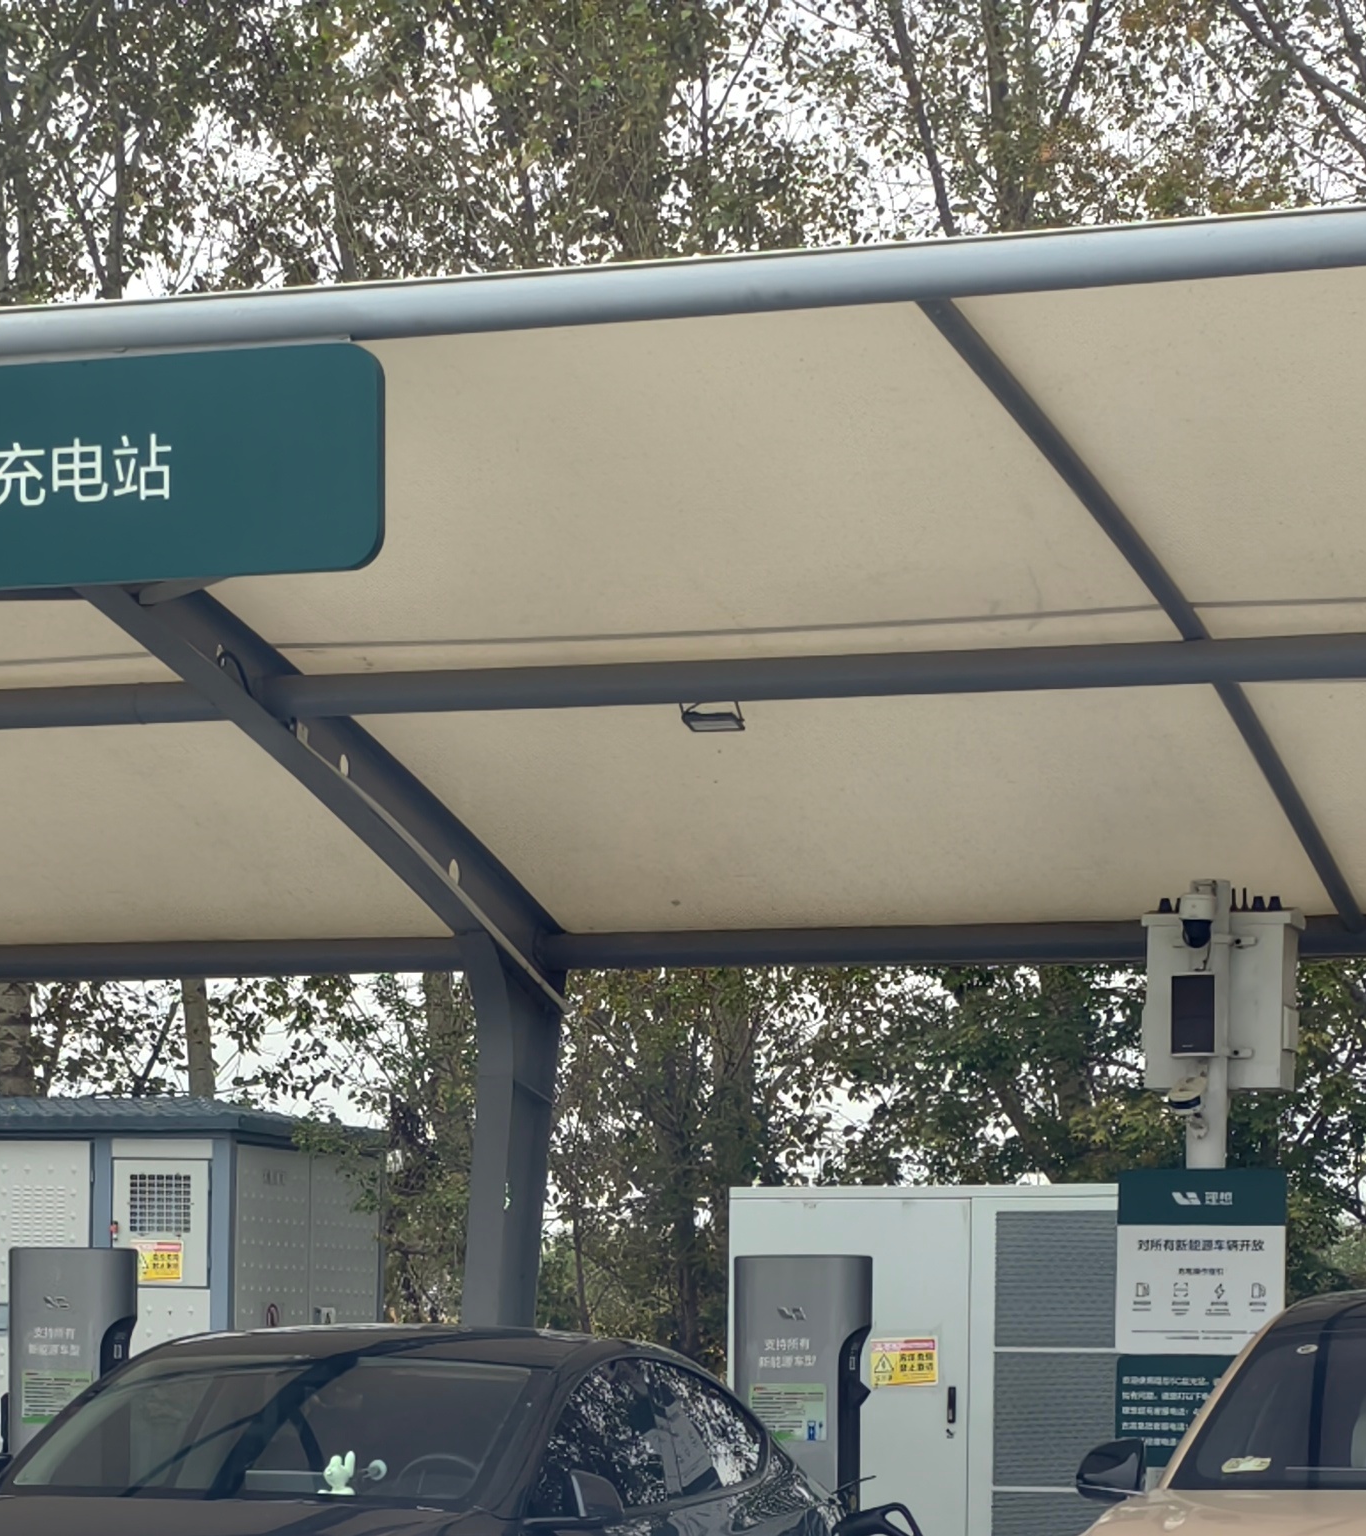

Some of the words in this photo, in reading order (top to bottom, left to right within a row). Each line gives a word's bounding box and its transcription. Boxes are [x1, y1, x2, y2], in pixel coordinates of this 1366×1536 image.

[1205, 1191, 1233, 1205] 理想
[1137, 1238, 1265, 1252] 对所有新能源车辆开放
[763, 1337, 810, 1351] 支持所有
[758, 1354, 817, 1369] 新能源车型
